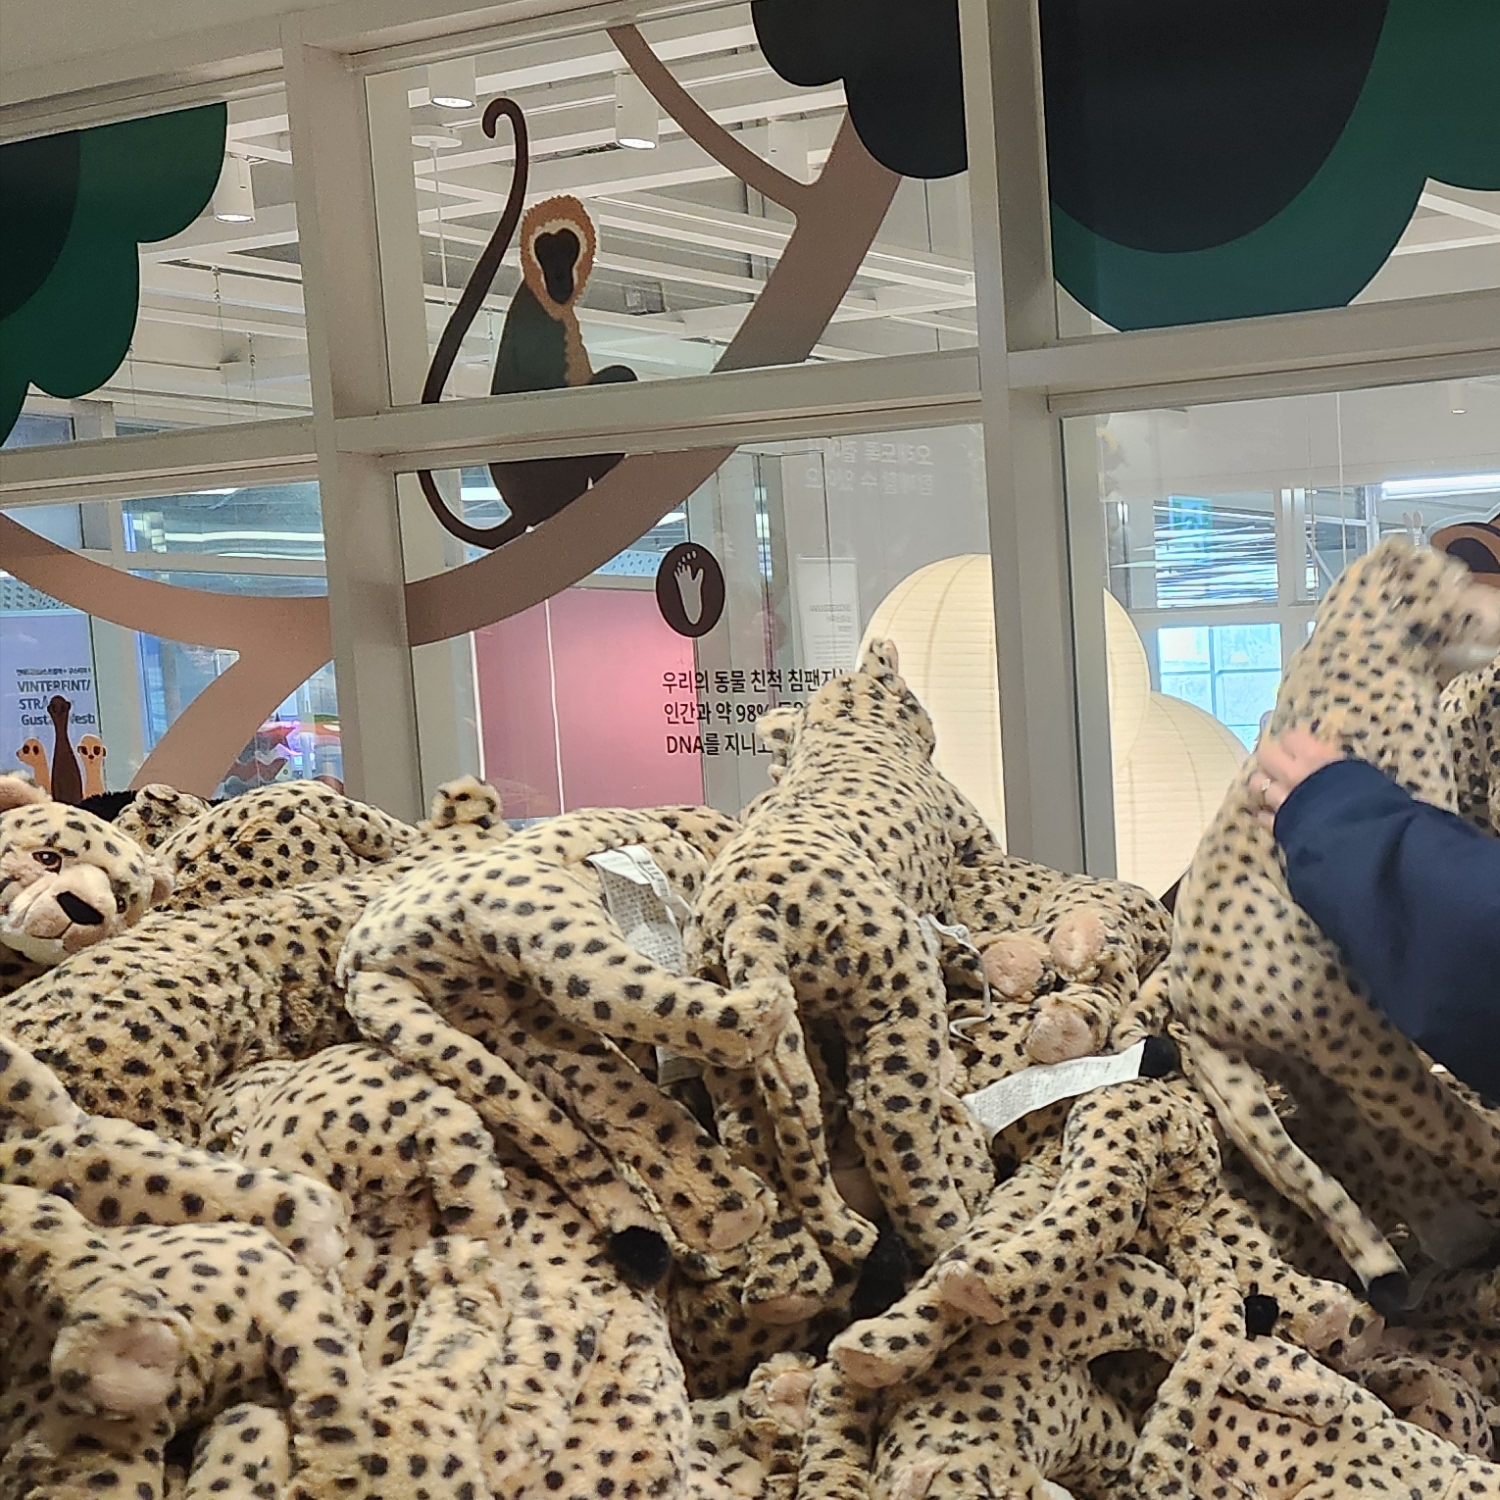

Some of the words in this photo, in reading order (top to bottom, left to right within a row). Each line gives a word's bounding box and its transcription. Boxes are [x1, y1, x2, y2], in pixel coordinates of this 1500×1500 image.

[662, 671, 709, 694] 우리의
[714, 670, 746, 693] 동물
[750, 669, 783, 693] 친척
[788, 668, 842, 692] 침팬지
[664, 702, 711, 725] 인간과
[716, 702, 732, 724] 약
[667, 733, 721, 756] DNA를
